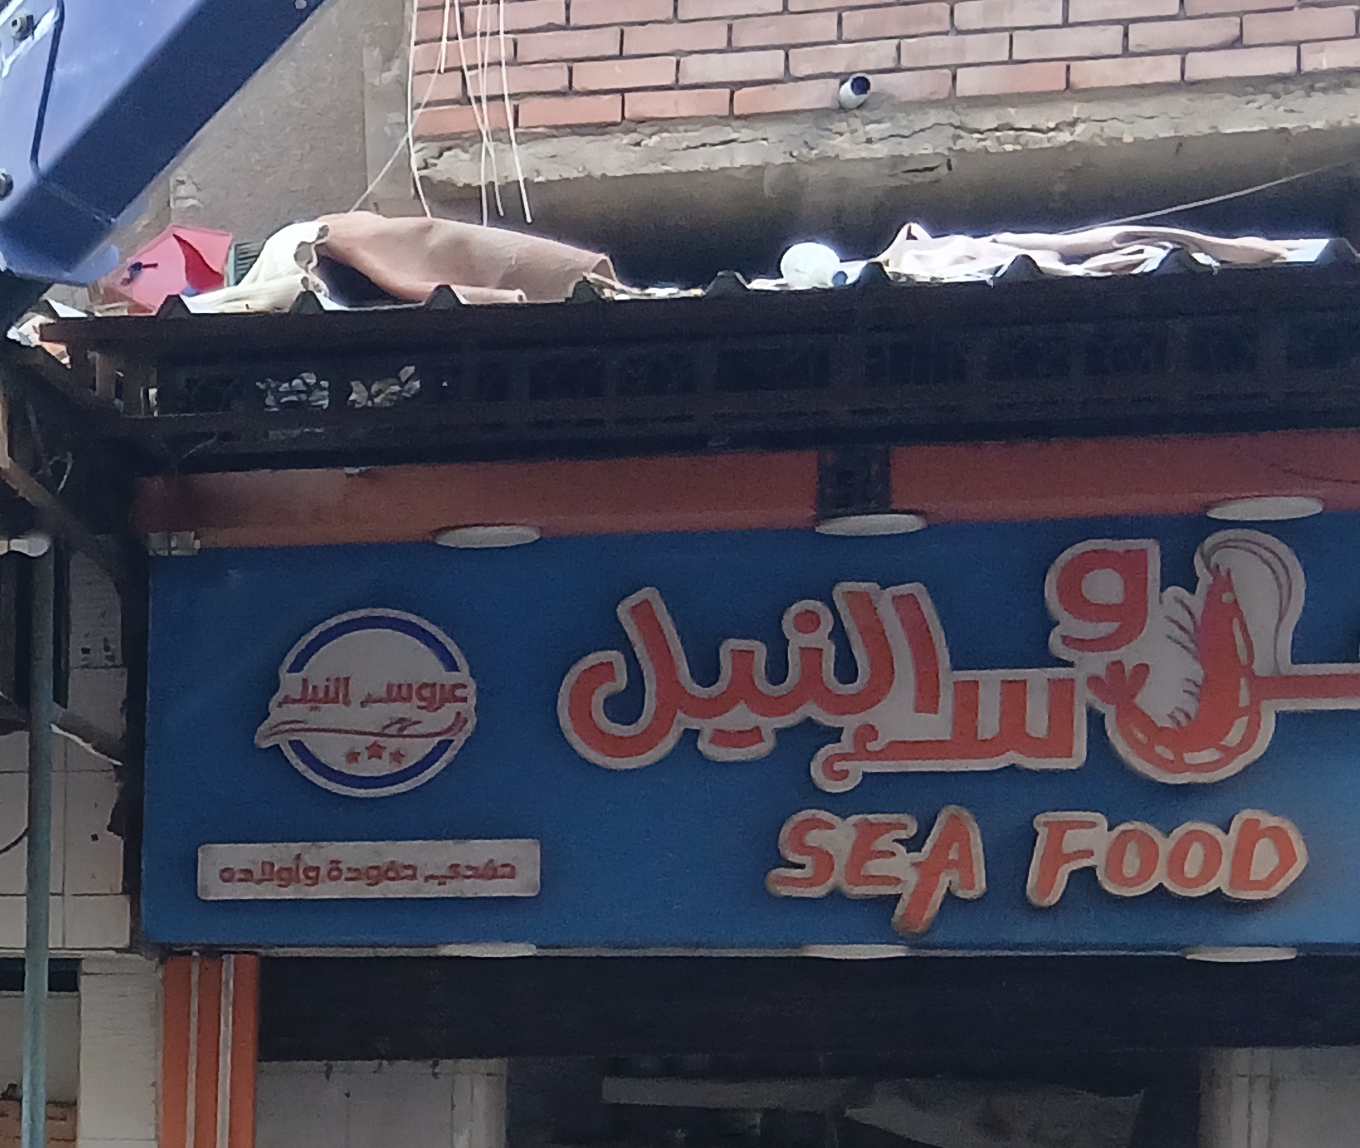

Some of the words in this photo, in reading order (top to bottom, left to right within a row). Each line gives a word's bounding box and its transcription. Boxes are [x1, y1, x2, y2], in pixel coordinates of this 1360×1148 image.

[276, 675, 352, 713] النيل
[359, 681, 469, 714] عروس
[567, 588, 942, 760] النيل
[821, 545, 1360, 782] روس
[218, 852, 322, 889] وأولاده
[767, 804, 983, 936] SEA
[1030, 813, 1298, 906] FOOD
